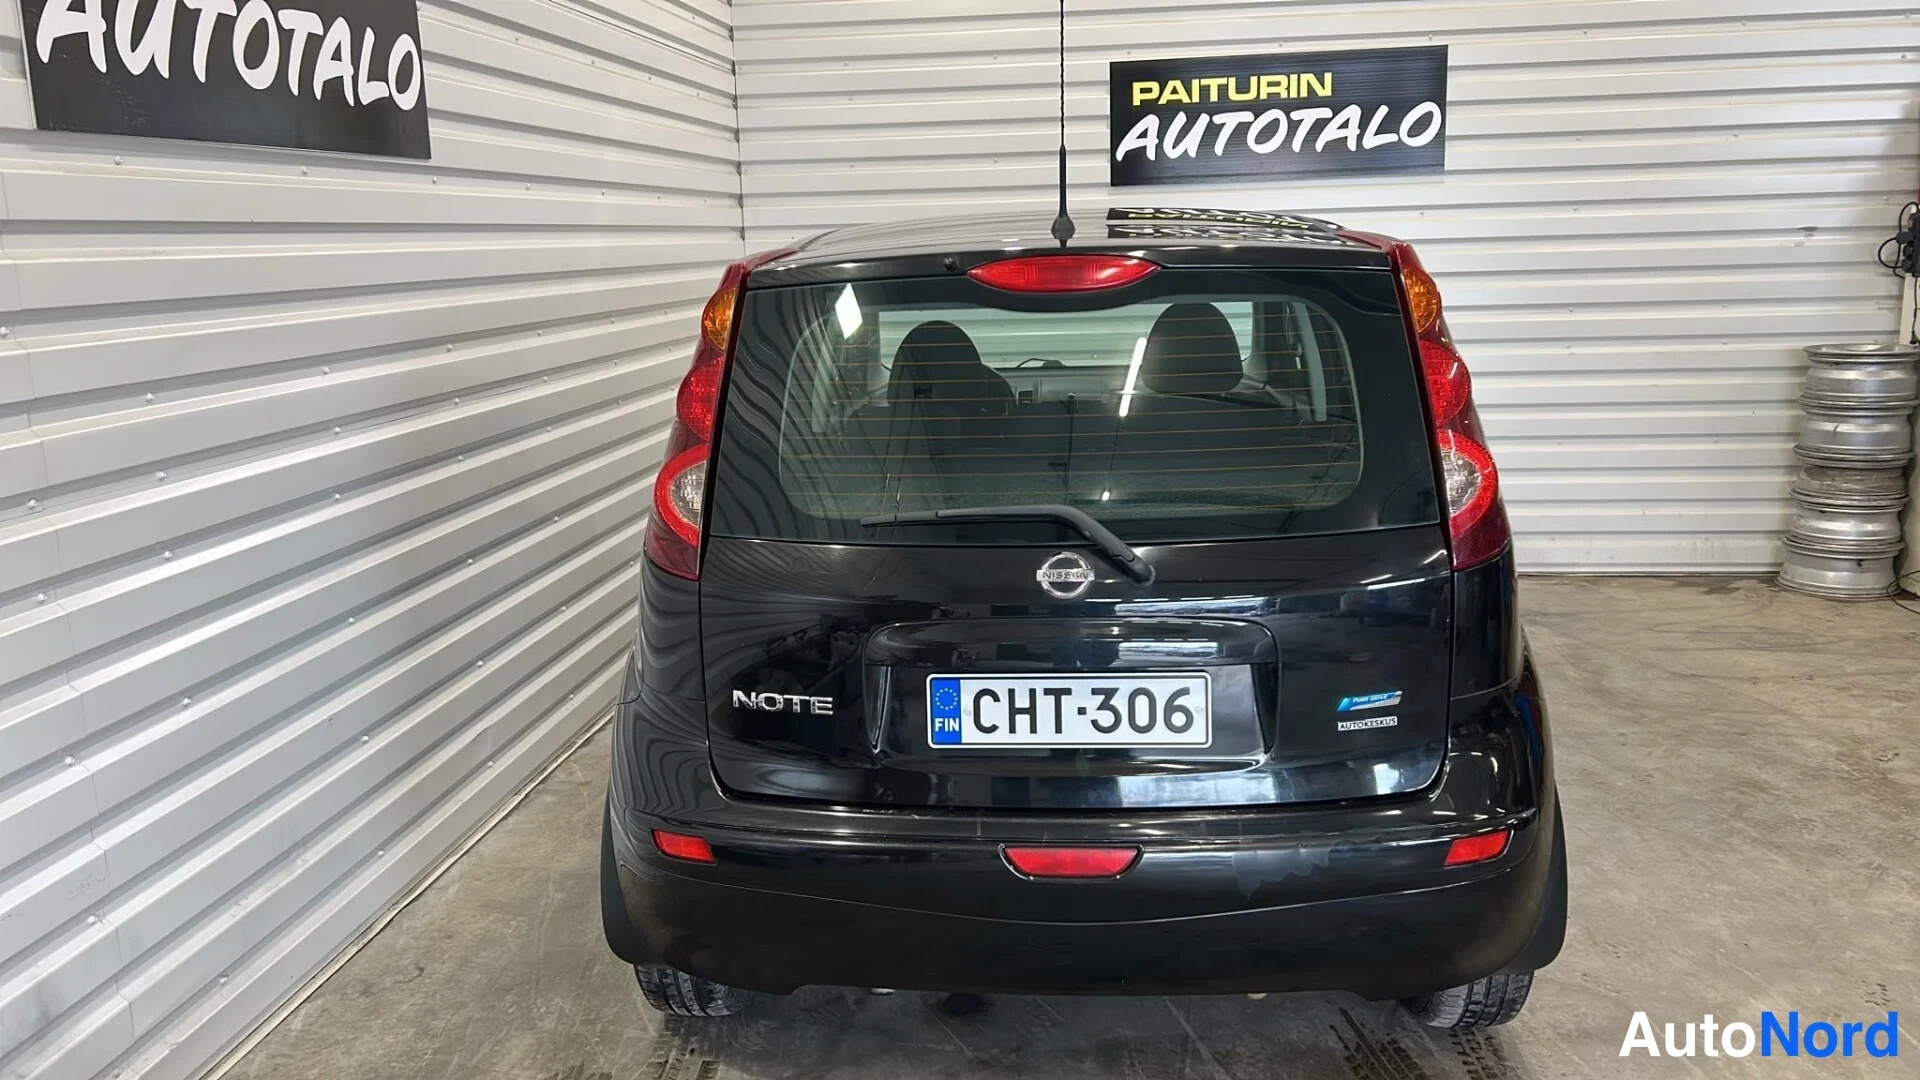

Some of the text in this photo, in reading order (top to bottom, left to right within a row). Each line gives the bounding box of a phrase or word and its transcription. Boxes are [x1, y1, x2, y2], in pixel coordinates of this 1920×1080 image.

[36, 0, 421, 111] AUTOTALO
[1132, 72, 1333, 106] PAITURIN
[1116, 101, 1442, 162] AUTOTALO
[732, 689, 834, 716] NOTE
[972, 687, 1195, 735] CHT-306
[934, 717, 960, 733] FIN
[1339, 717, 1397, 730] AUTOKESKUS
